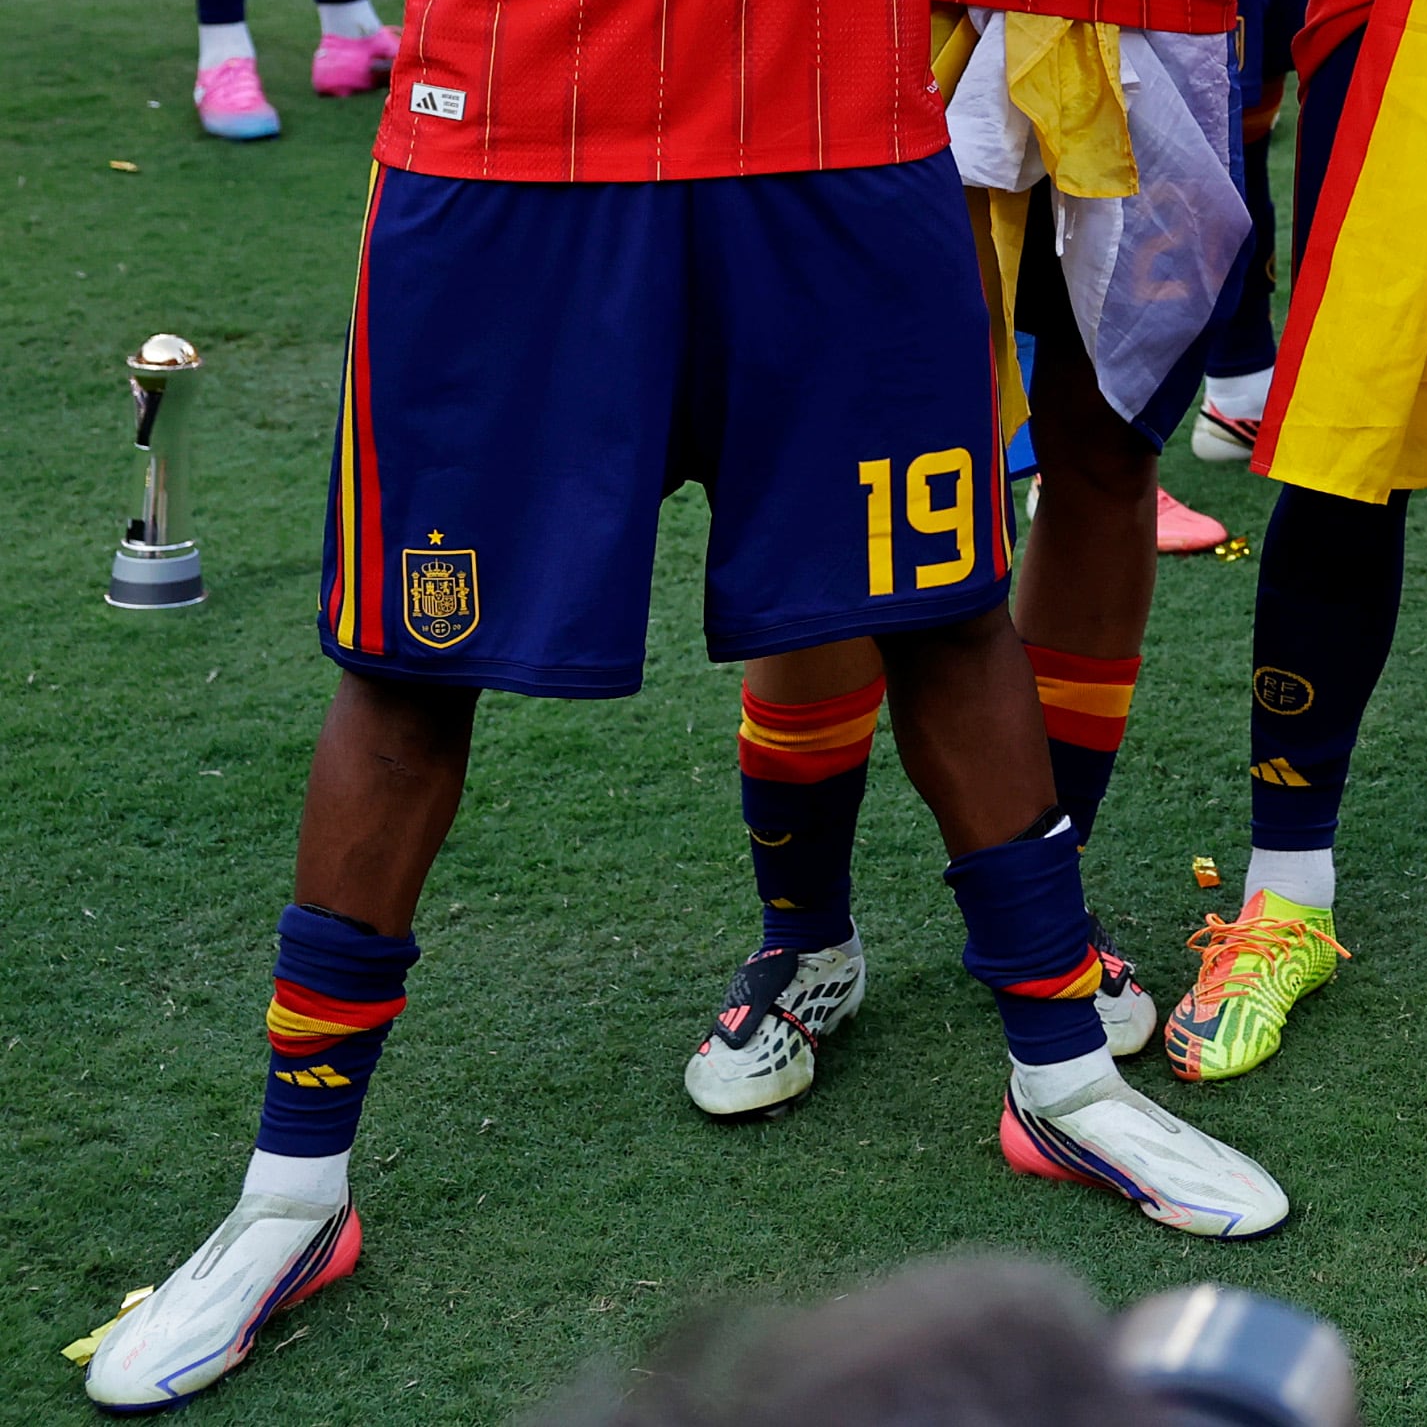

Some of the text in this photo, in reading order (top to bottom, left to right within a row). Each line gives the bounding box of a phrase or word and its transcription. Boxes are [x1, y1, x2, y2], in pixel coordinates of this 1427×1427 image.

[859, 447, 976, 597] 19
[1264, 675, 1297, 693] RF
[1263, 687, 1297, 705] EF
